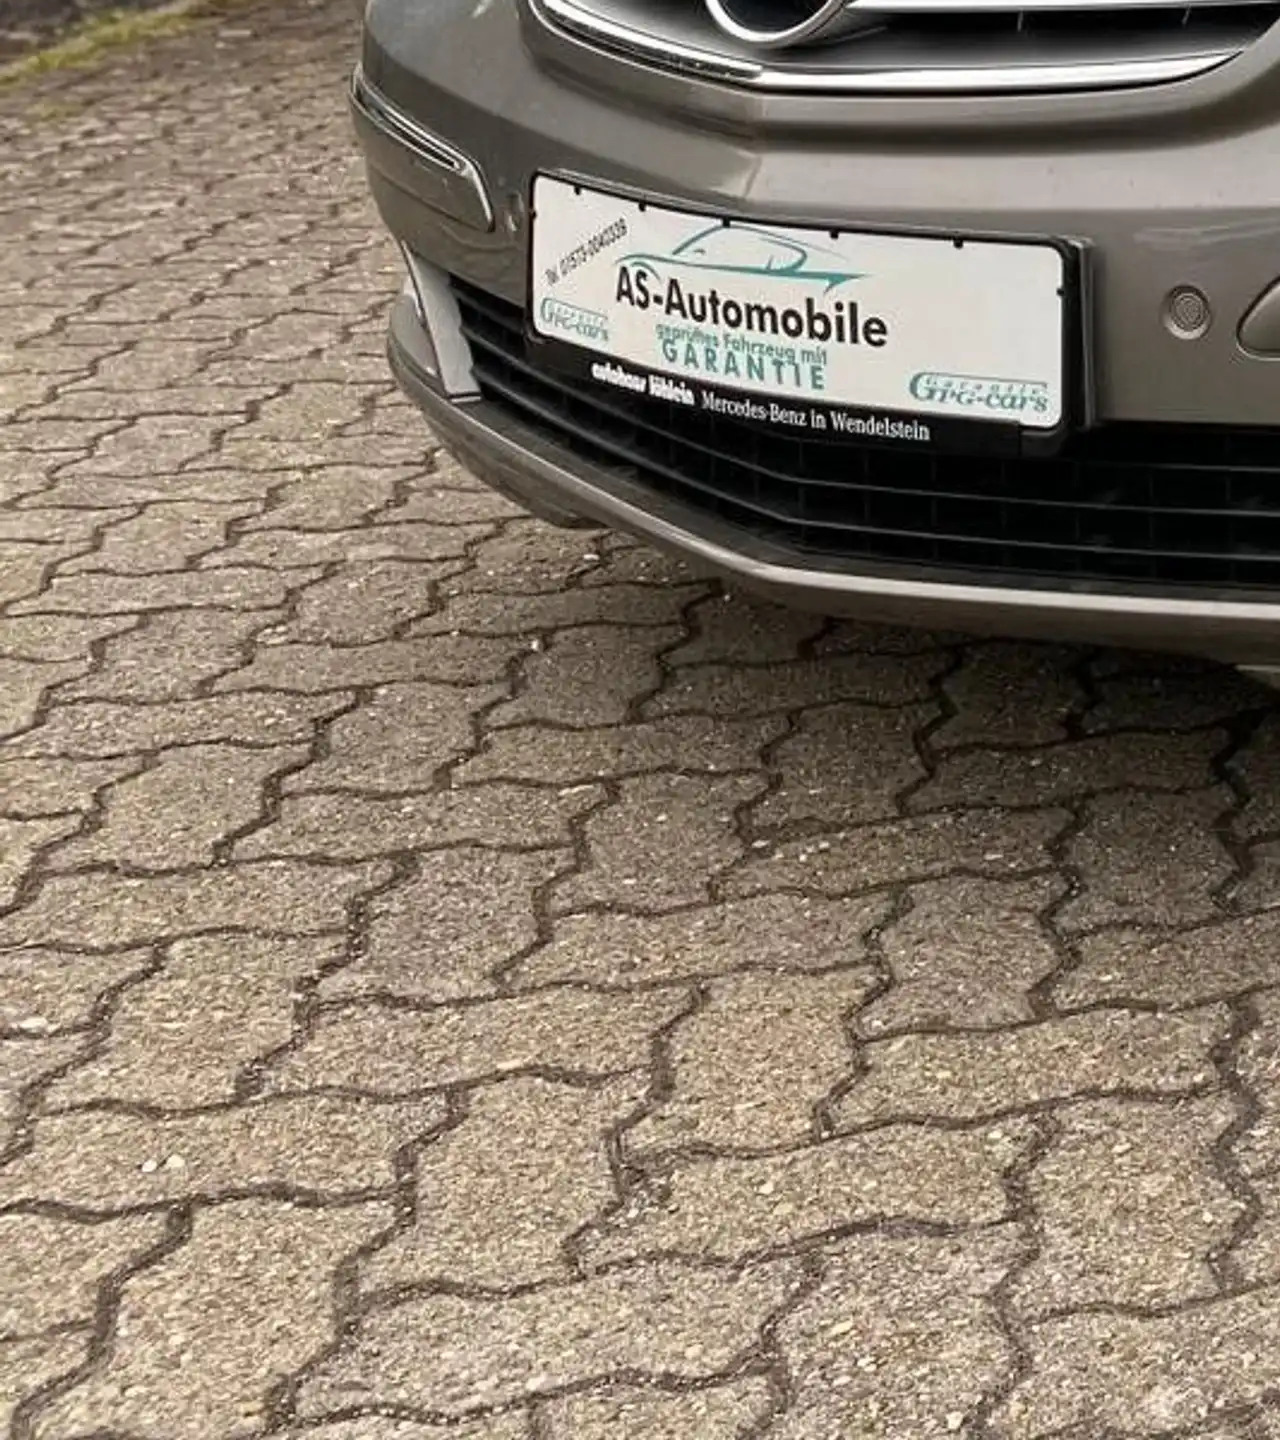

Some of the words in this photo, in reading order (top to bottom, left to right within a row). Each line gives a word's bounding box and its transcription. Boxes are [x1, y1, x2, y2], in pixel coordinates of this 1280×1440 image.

[616, 265, 888, 347] AS-Automobile
[662, 338, 825, 390] GARANTIE
[722, 334, 796, 366] Fahrzeug
[800, 345, 828, 366] mit
[702, 390, 808, 427] Mercedes-Benz
[810, 408, 827, 430] in
[830, 410, 931, 442] Wendelstein
